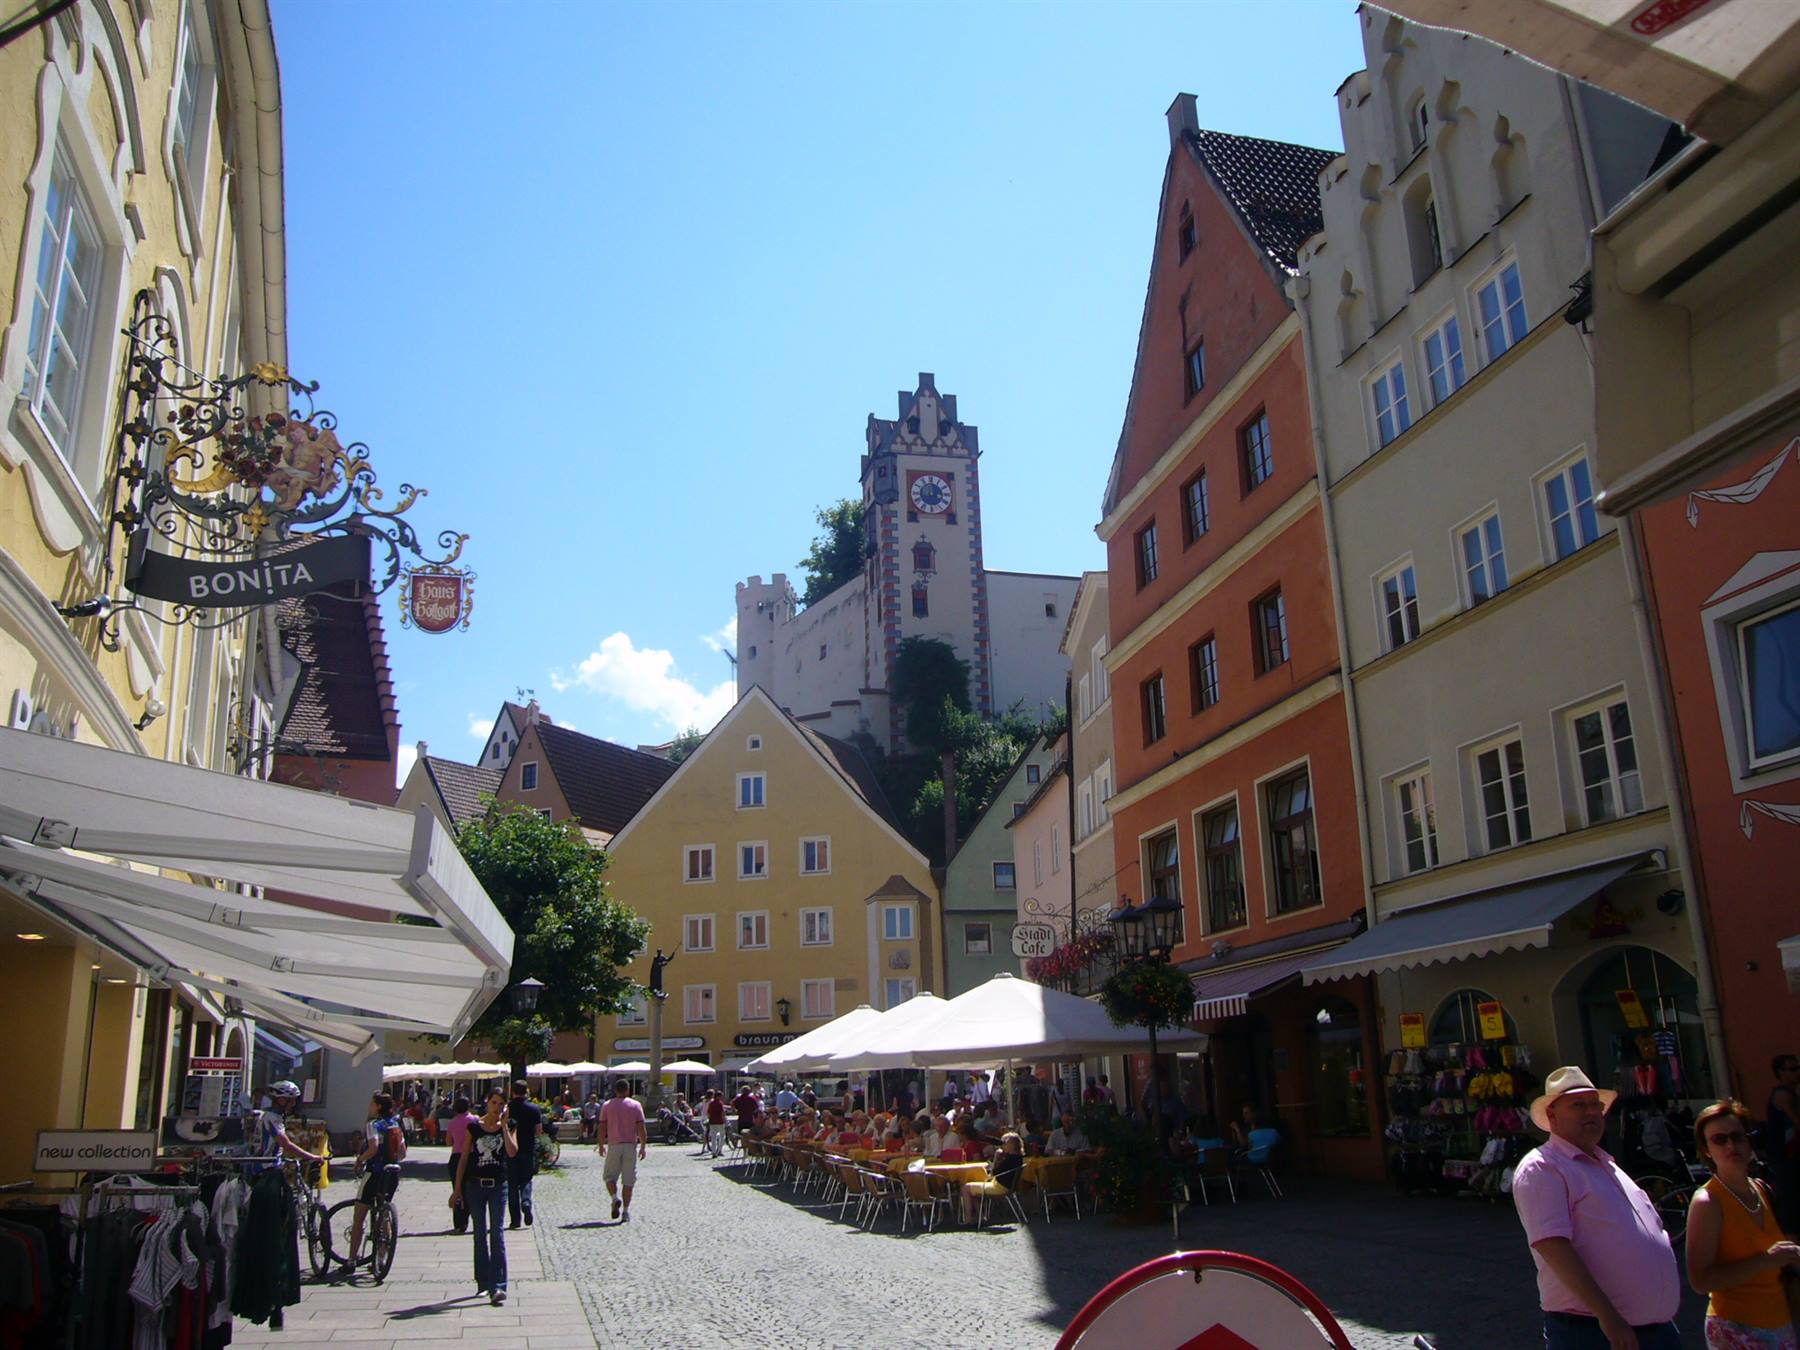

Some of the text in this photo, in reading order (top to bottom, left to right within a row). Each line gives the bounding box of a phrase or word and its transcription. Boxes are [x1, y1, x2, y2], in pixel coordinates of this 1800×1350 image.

[1016, 927, 1050, 941] Stadt
[740, 1035, 780, 1045] braun
[40, 1144, 151, 1158] new collection
